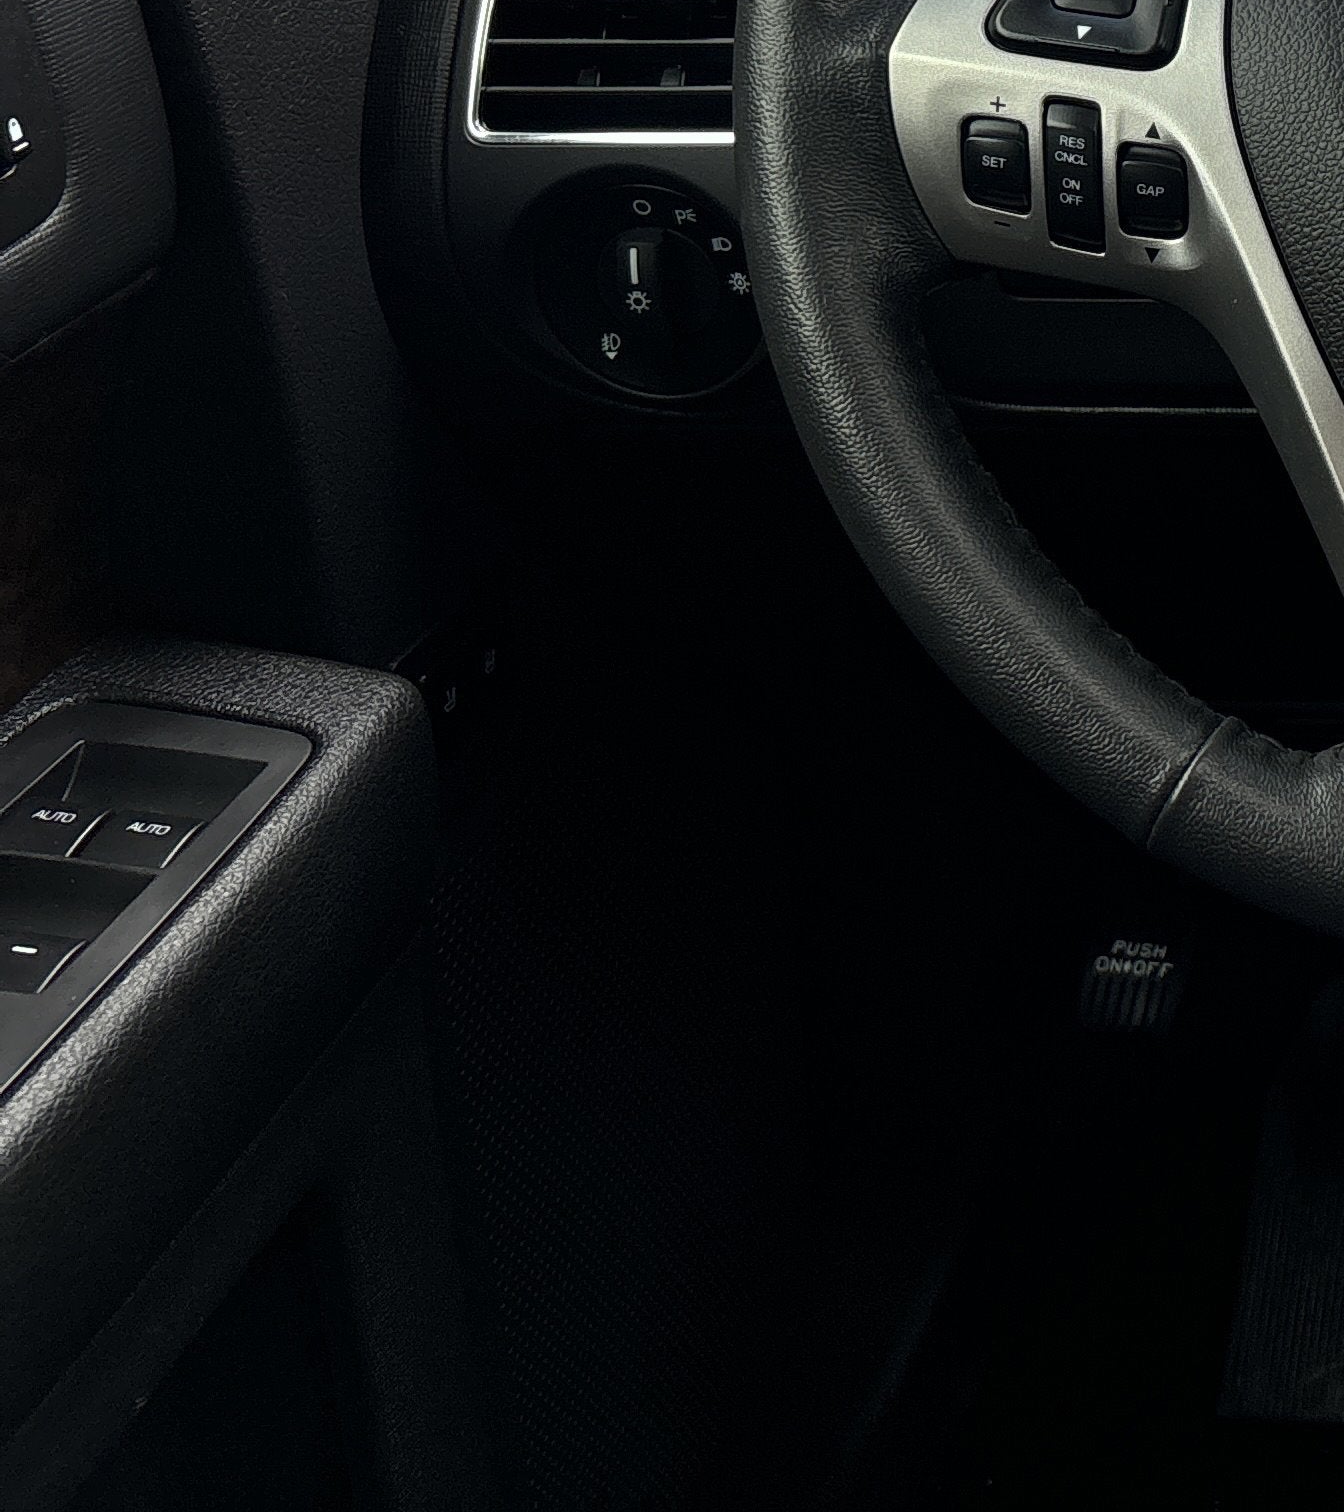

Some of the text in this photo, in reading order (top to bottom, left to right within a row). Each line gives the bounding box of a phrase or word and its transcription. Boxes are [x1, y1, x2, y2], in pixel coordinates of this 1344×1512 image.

[1060, 135, 1085, 149] RES
[982, 155, 1006, 168] SET
[1055, 151, 1087, 165] CNCL
[1063, 178, 1080, 190] ON
[1137, 184, 1164, 196] GAP
[1060, 193, 1083, 205] OFF
[32, 810, 76, 822] AUTO
[126, 822, 171, 835] AUTO
[1111, 940, 1167, 959] PUSH
